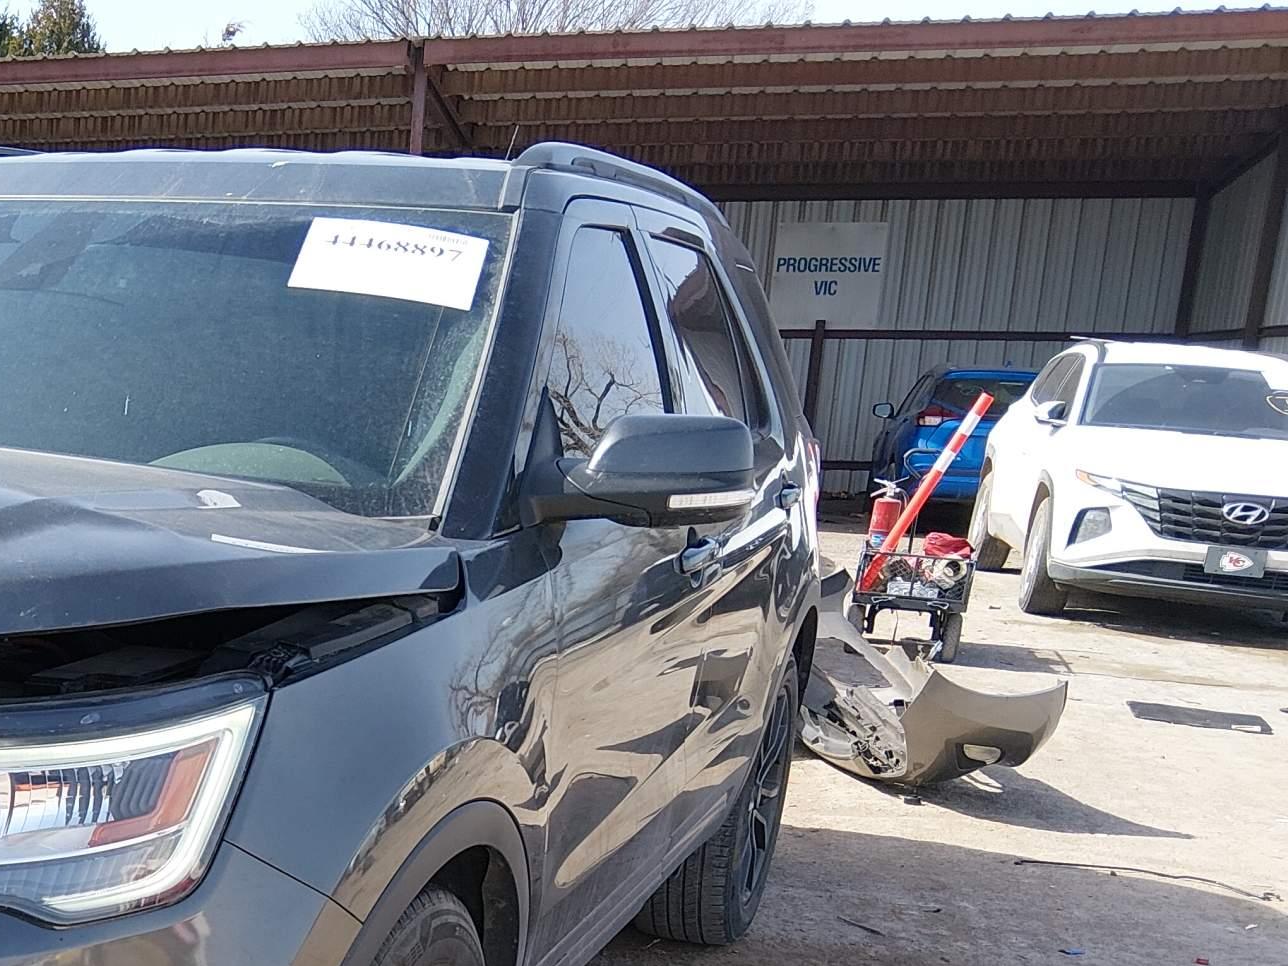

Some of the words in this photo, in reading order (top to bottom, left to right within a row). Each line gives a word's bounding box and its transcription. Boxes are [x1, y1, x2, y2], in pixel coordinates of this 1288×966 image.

[324, 234, 463, 262] 44468897
[776, 257, 881, 272] PROGRESSIVE
[814, 280, 838, 295] VIC
